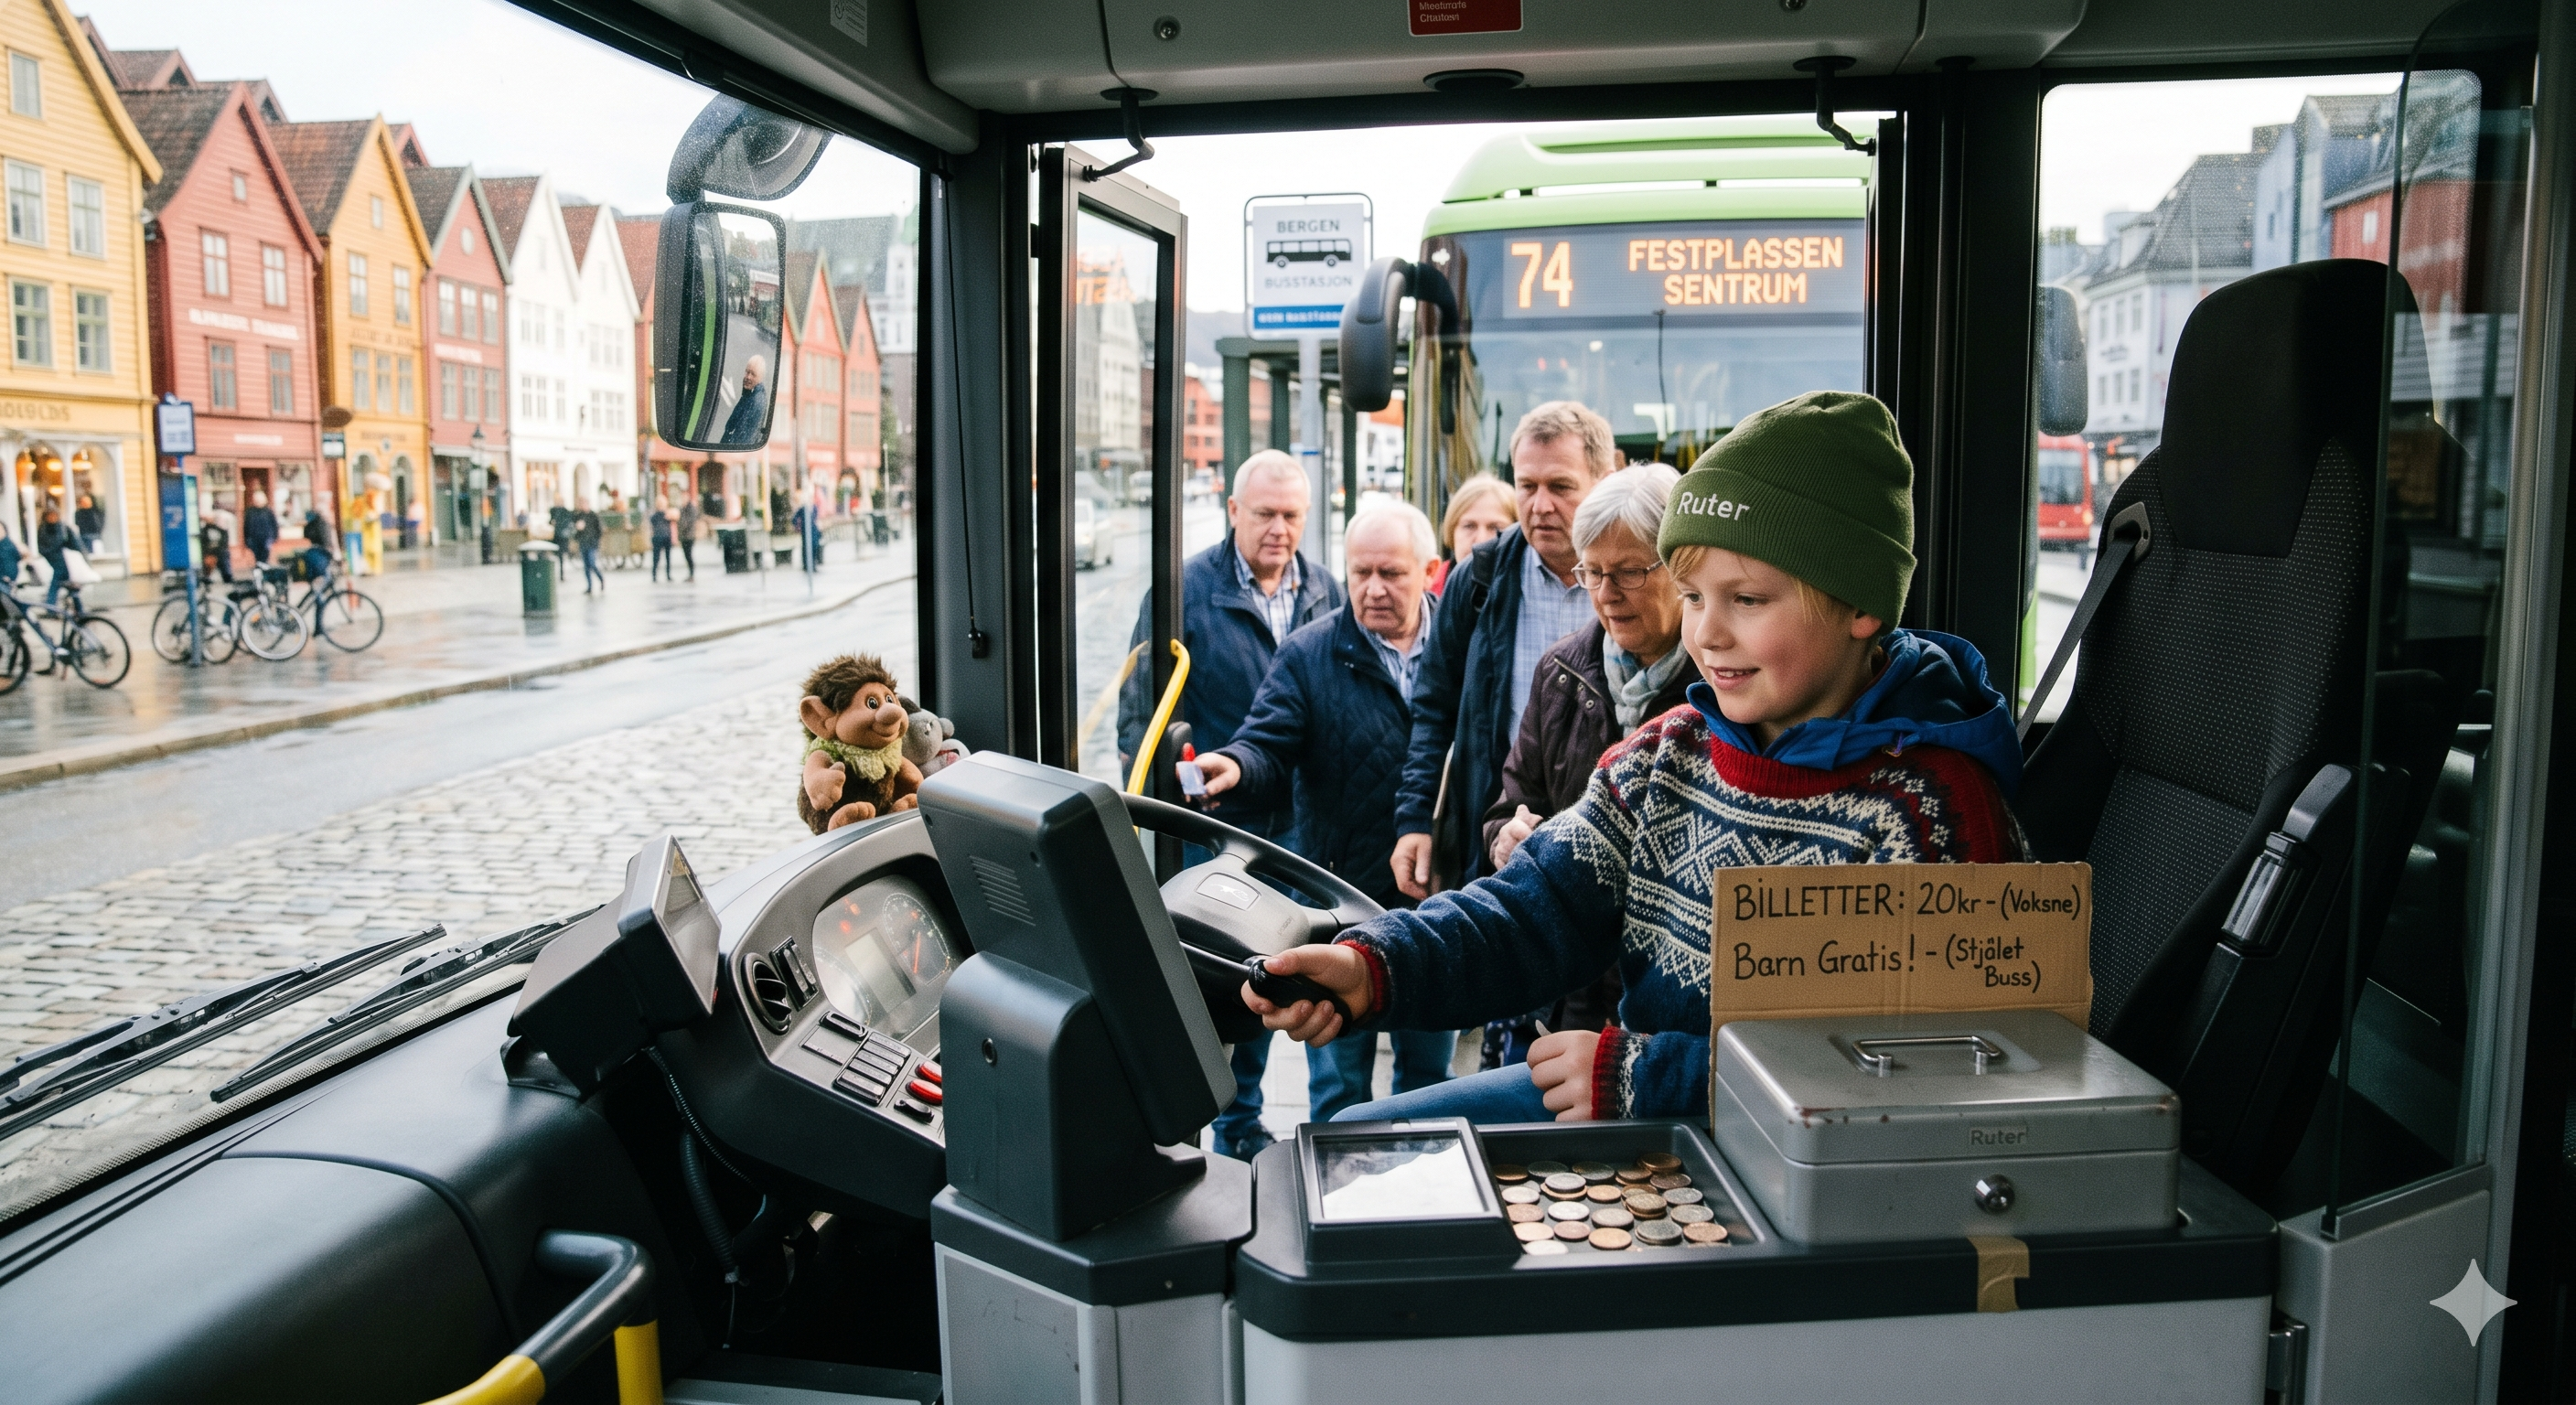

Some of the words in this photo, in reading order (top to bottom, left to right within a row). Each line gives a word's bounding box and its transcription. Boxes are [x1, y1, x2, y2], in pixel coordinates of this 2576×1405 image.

[1276, 220, 1340, 233] BERGEN
[1628, 236, 1843, 271] FESTPLASSEN
[1264, 275, 1353, 289] BUSSTASJON
[1510, 241, 1573, 308] 74
[1663, 273, 1808, 305] SENTRUM
[1676, 491, 1751, 520] Ruter
[1733, 942, 1806, 981] Barn
[1818, 934, 1916, 974] Gratis!
[1984, 960, 2042, 994] Buss)
[1970, 1129, 2025, 1145] Ruter
